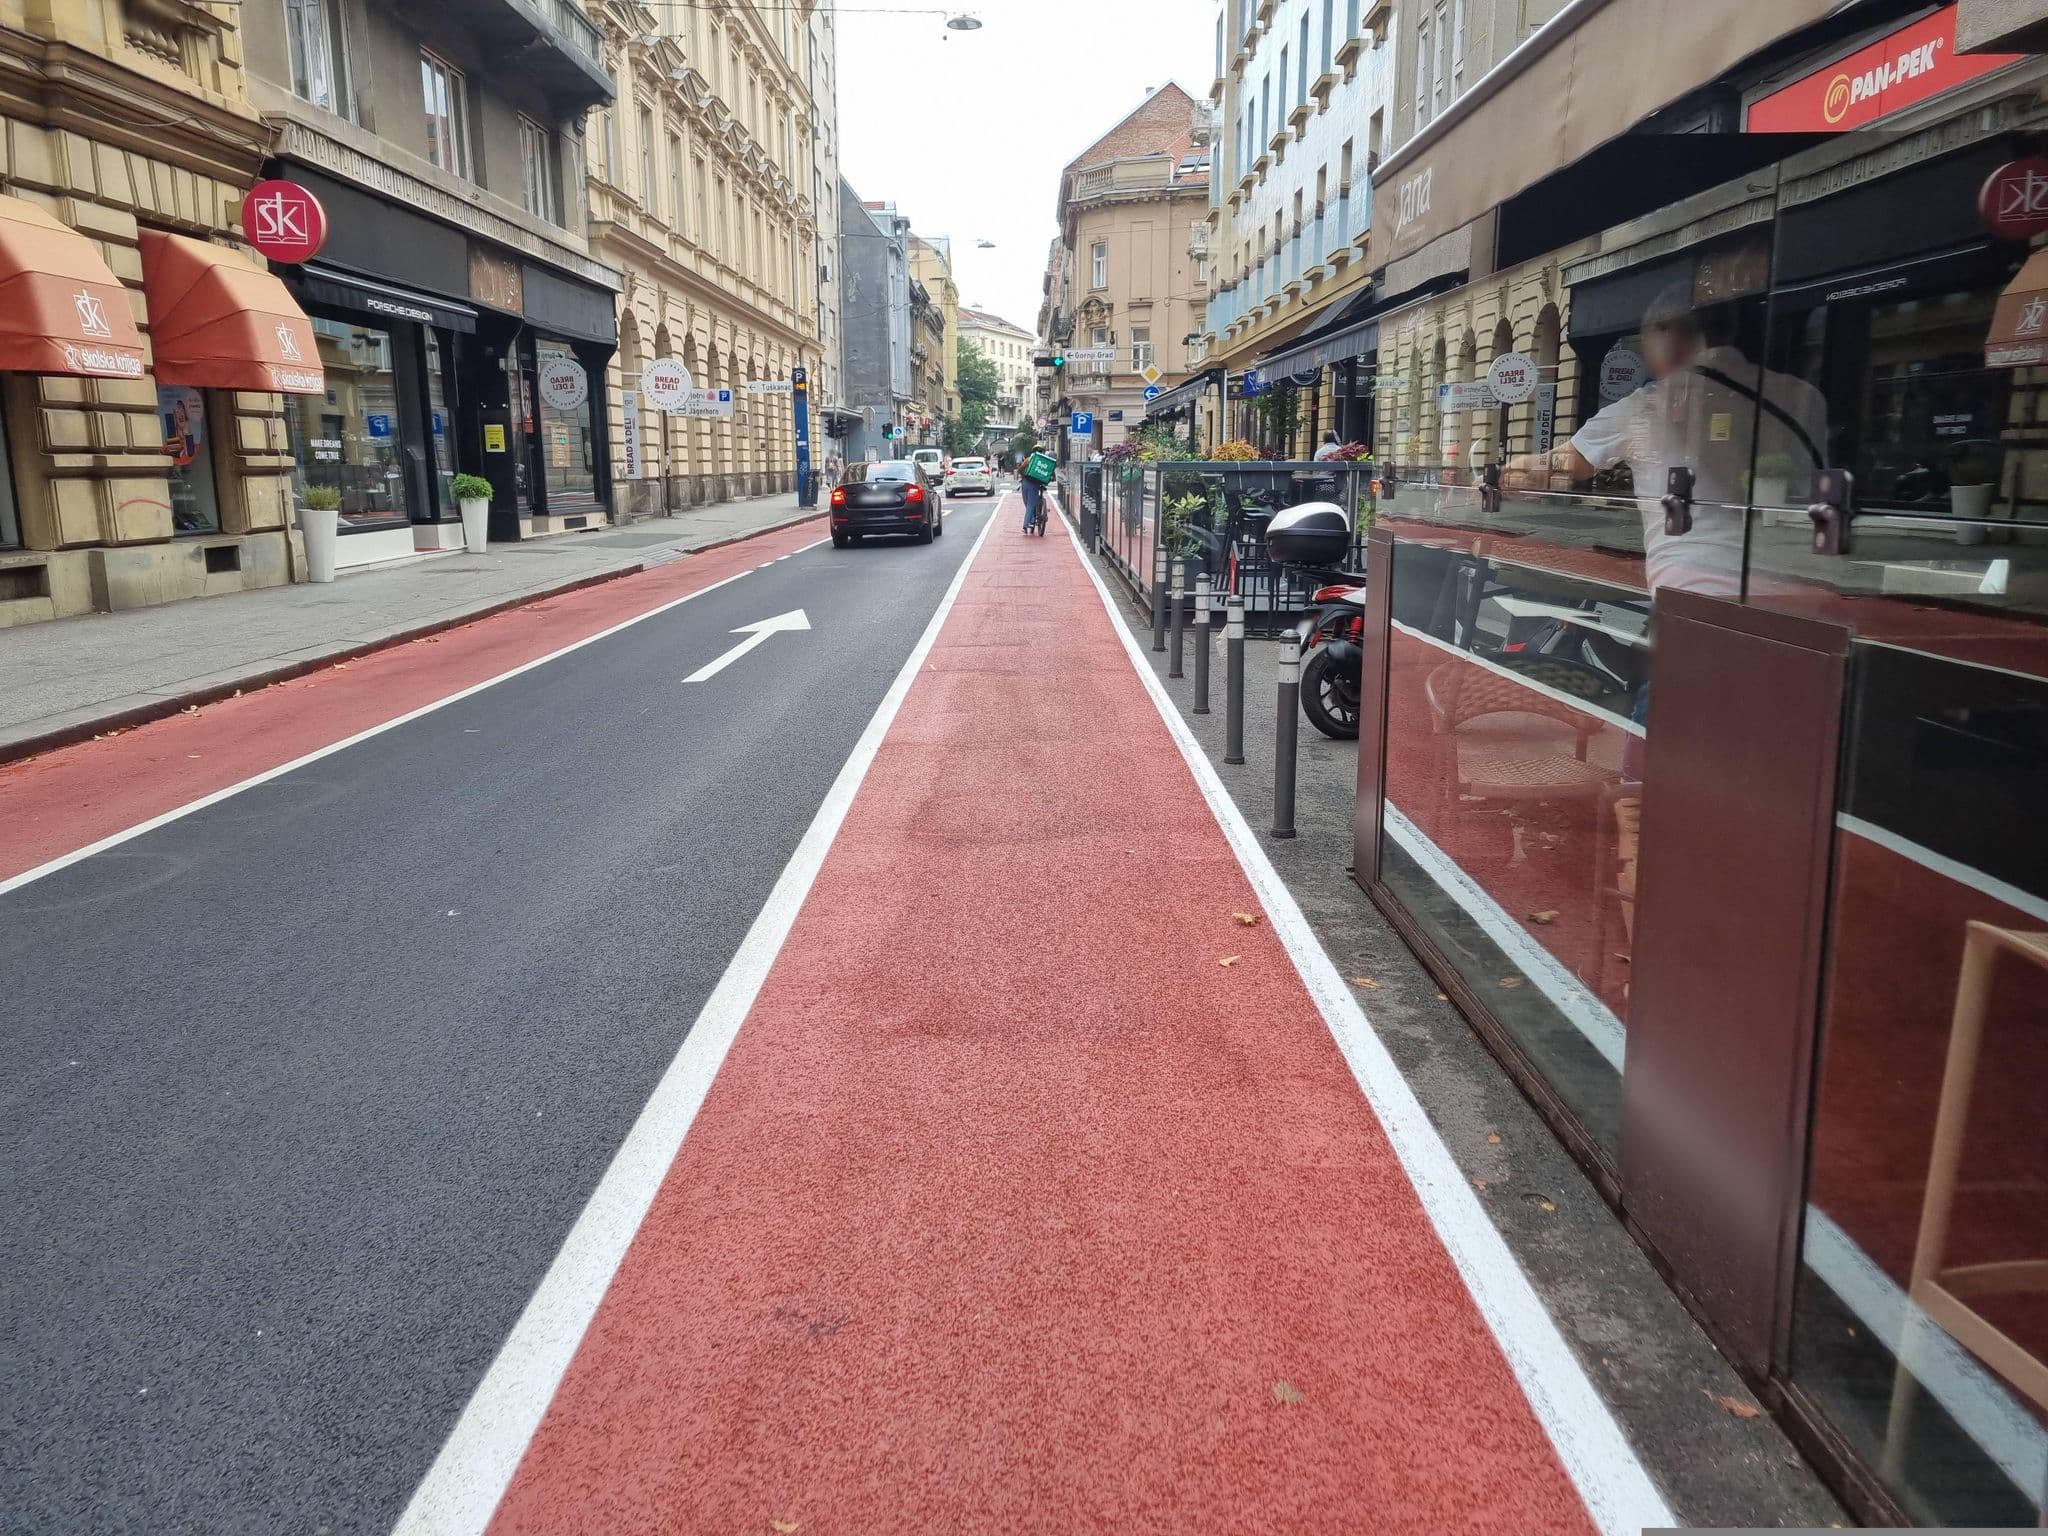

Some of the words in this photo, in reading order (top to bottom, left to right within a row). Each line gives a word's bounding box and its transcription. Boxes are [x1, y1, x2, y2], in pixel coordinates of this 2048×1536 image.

[1849, 39, 1938, 105] PAN-PEK
[367, 299, 405, 316] PORSCHE
[404, 308, 433, 321] DESIGN
[1097, 351, 1113, 359] Grad
[654, 375, 680, 385] BREAD
[655, 382, 661, 390] &
[661, 383, 678, 391] DELI
[624, 418, 632, 437] DELI
[1077, 416, 1087, 429] P
[626, 436, 633, 445] &
[626, 446, 635, 475] BREAD
